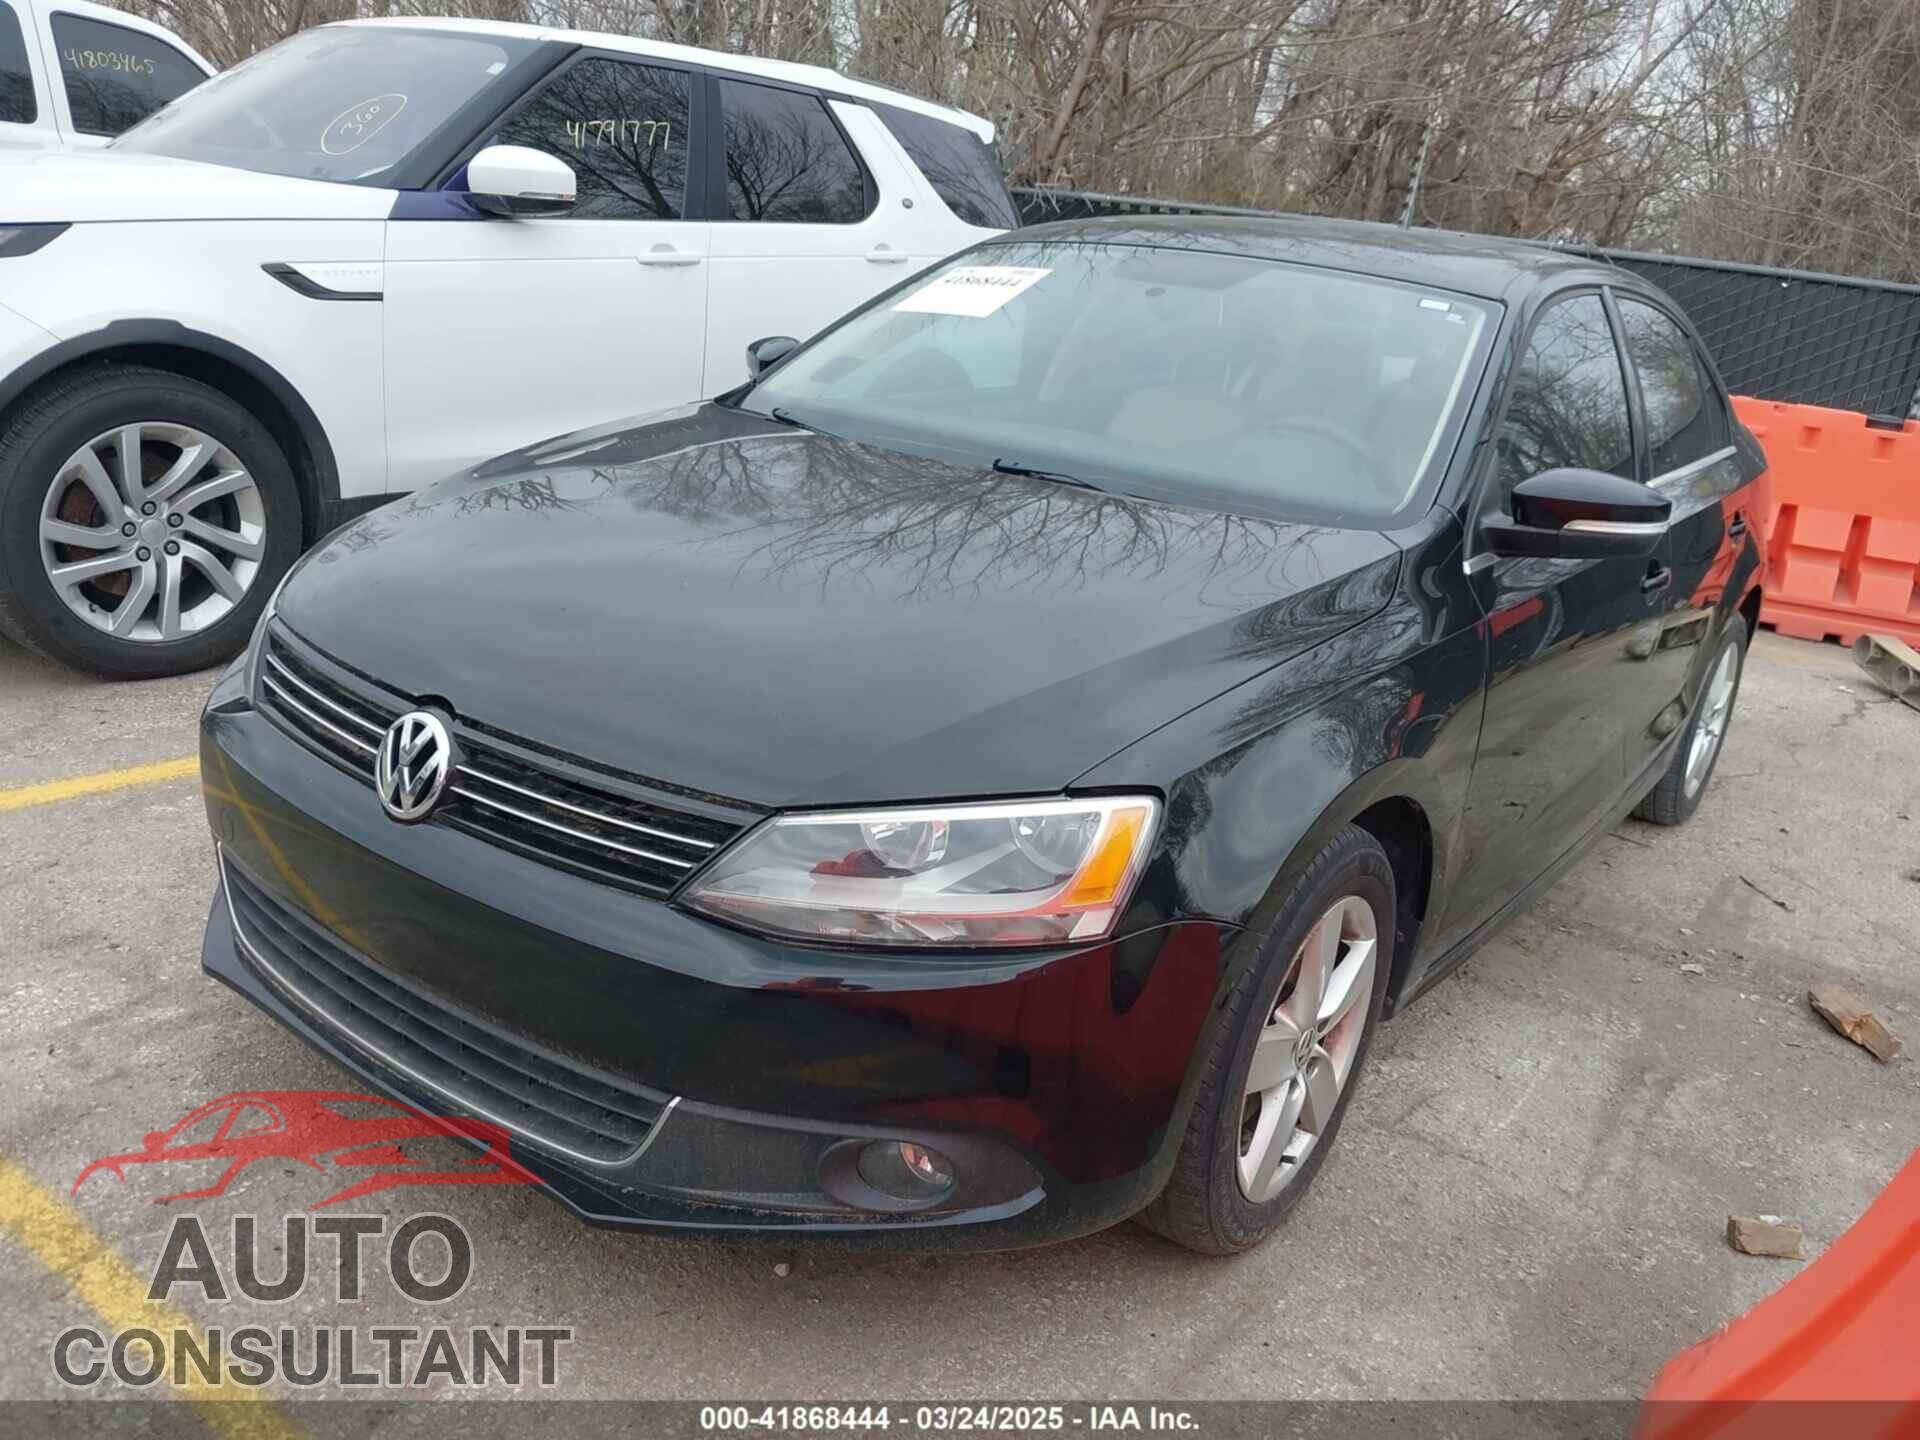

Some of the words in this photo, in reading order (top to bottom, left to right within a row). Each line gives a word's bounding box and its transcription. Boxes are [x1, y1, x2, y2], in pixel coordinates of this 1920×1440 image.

[64, 48, 155, 74] 41803465
[340, 105, 381, 135] 360
[566, 119, 671, 151] 41791777
